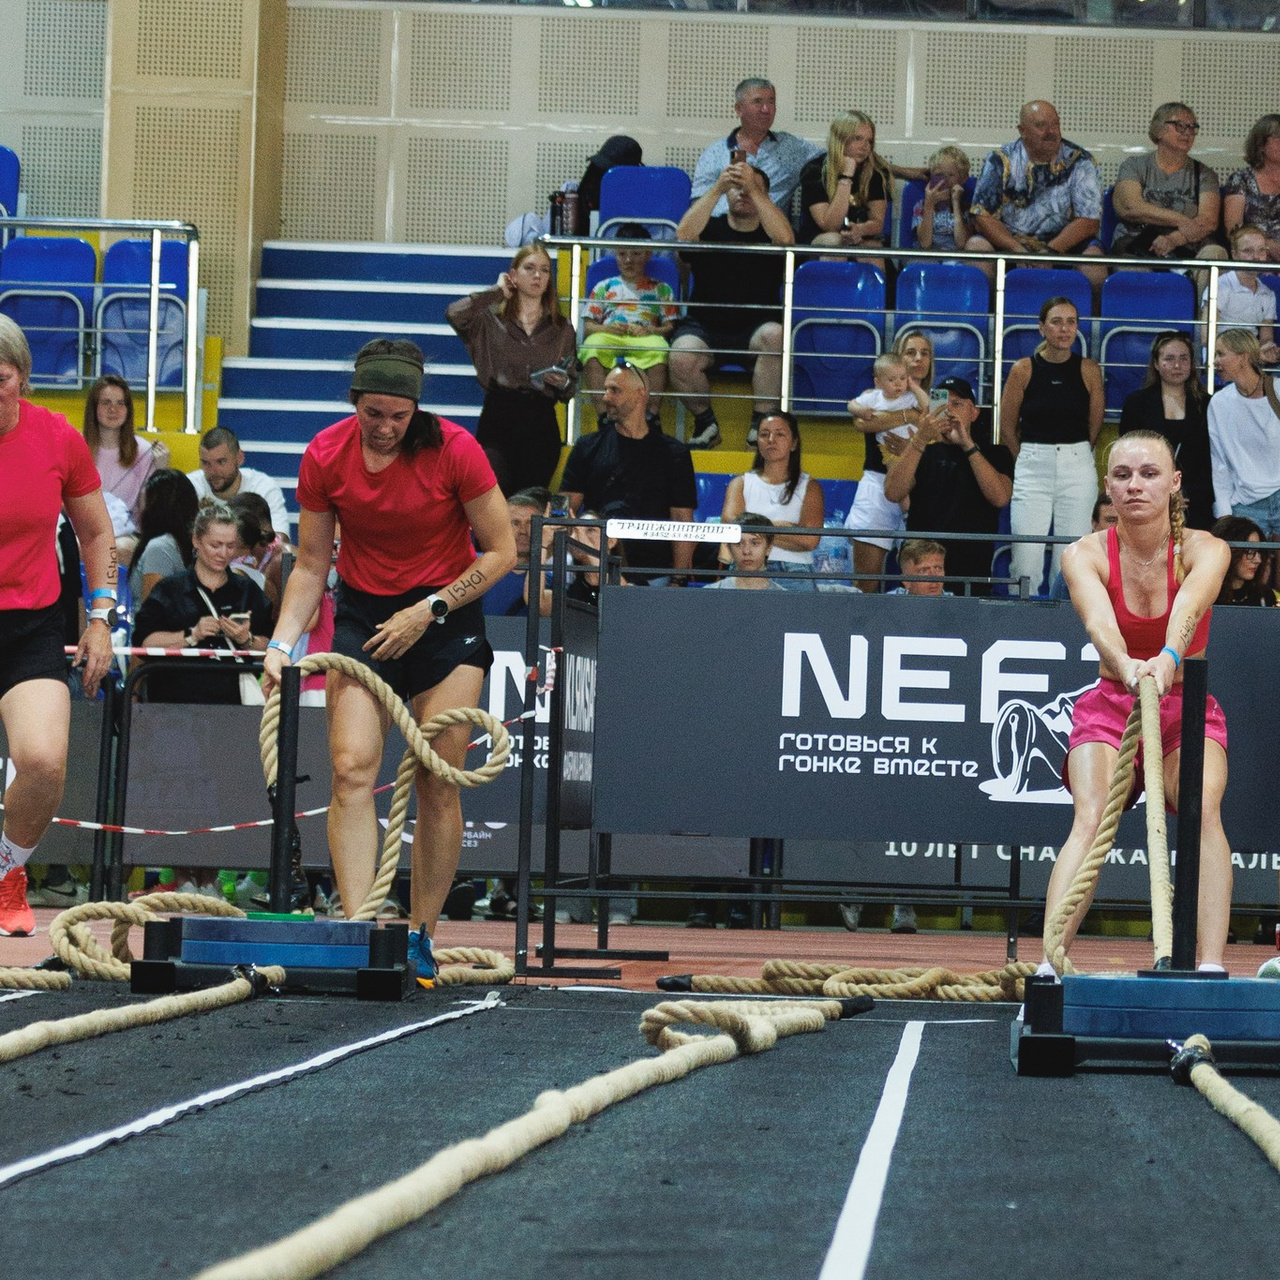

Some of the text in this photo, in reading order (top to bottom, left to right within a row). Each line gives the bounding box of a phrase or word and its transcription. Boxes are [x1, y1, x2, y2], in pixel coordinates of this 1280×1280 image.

[106, 546, 118, 586] 15401
[447, 569, 488, 602] 15401
[781, 632, 1101, 724] NEF
[779, 732, 910, 754] ГОТОВЬСЯ
